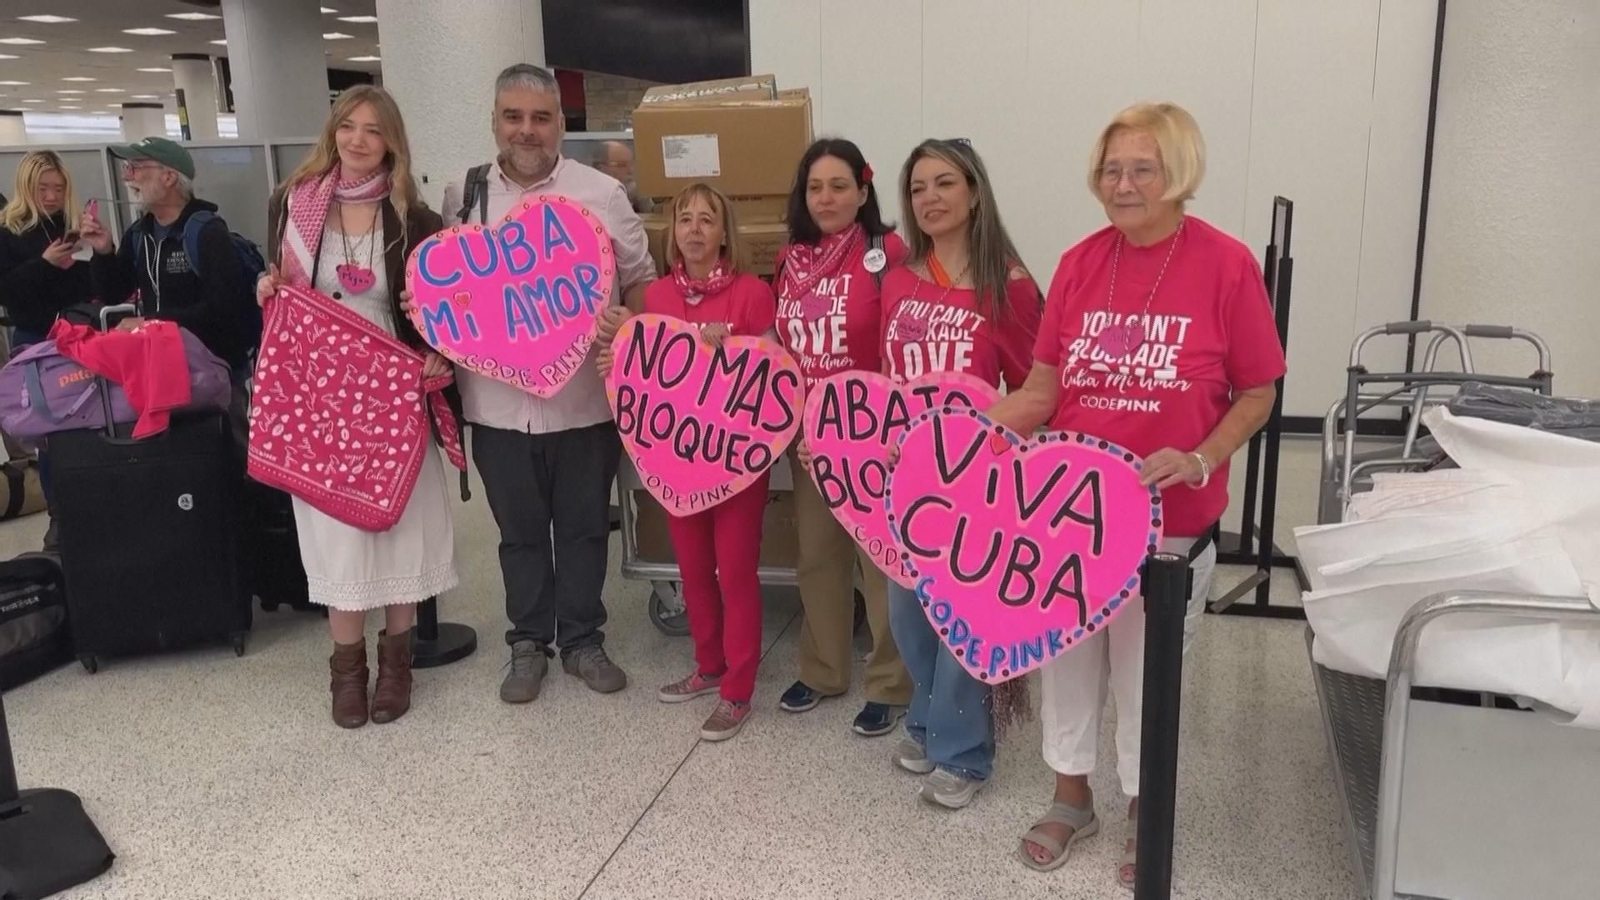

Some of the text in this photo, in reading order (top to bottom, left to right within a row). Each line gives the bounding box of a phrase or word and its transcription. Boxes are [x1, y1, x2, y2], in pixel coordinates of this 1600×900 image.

[418, 203, 575, 287] CUBA
[504, 264, 604, 340] AMOR
[623, 320, 798, 433] NO MAS
[1080, 395, 1161, 413] CODEPINK
[616, 384, 772, 476] BLOQUEO
[900, 496, 1087, 628] CUBA
